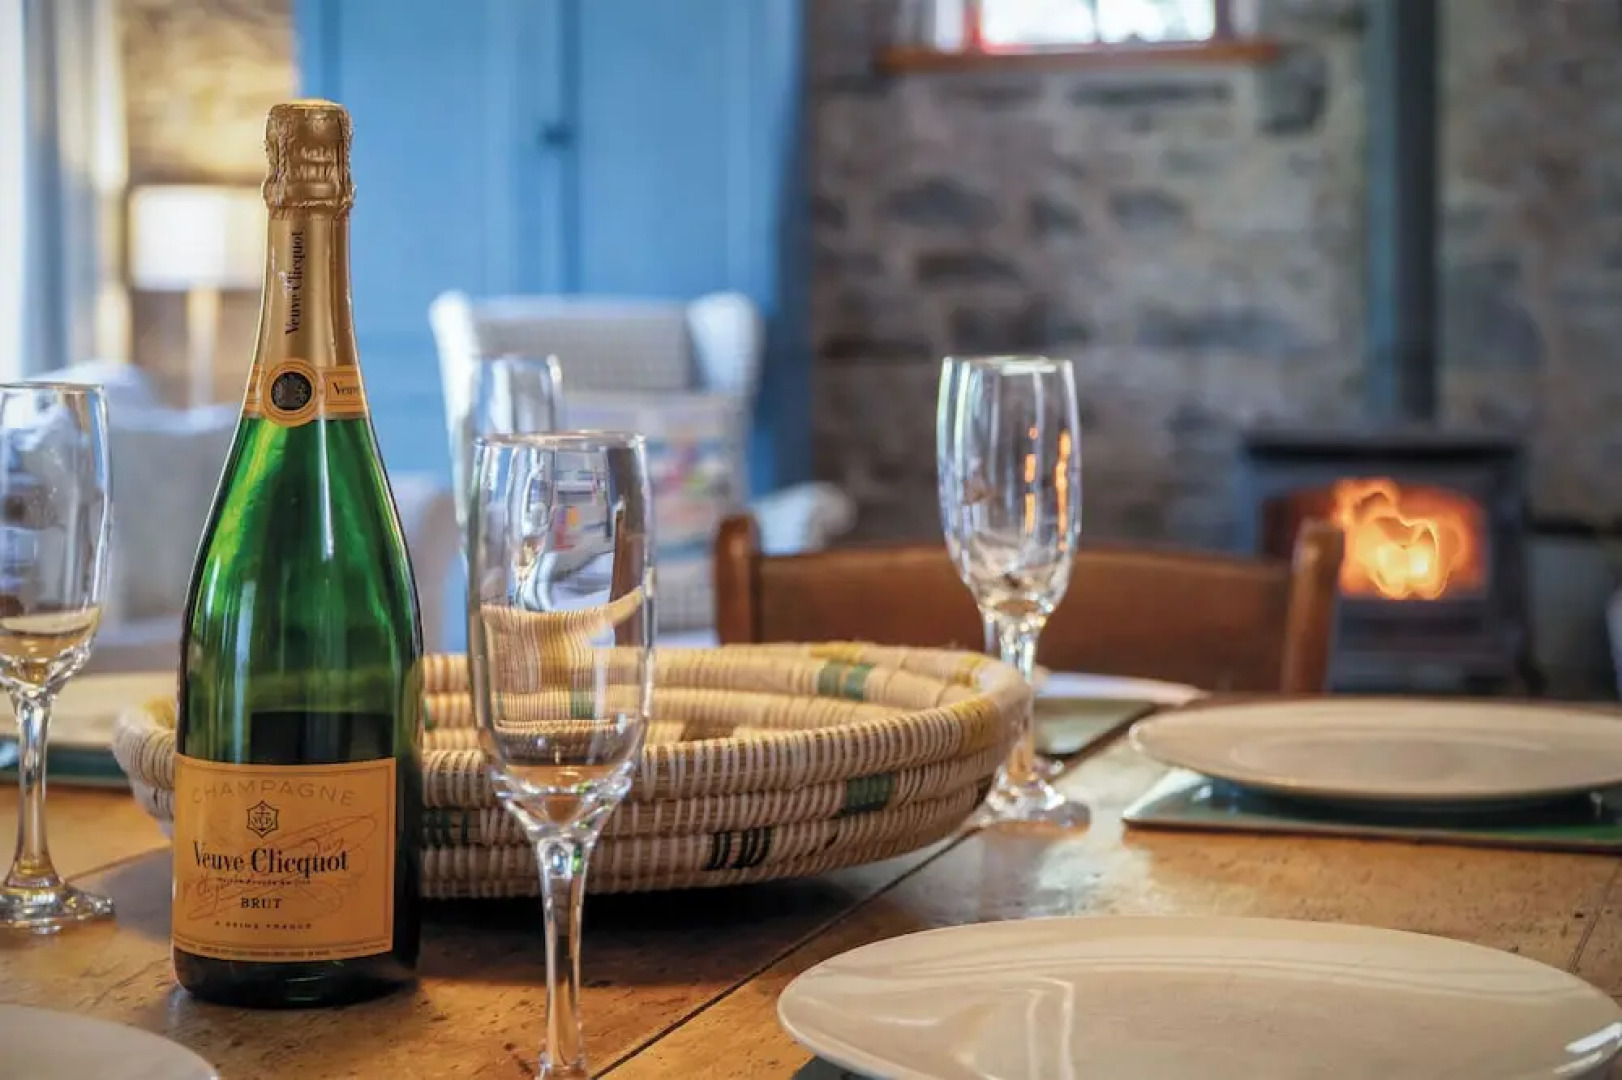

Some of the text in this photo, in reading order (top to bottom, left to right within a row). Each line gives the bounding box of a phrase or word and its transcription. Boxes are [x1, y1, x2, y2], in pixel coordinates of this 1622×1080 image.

[285, 232, 306, 335] Veuve Clicquot
[193, 780, 355, 805] CHAMPAGNE
[193, 839, 350, 878] Veuve Clicquot
[240, 897, 283, 909] BRUT
